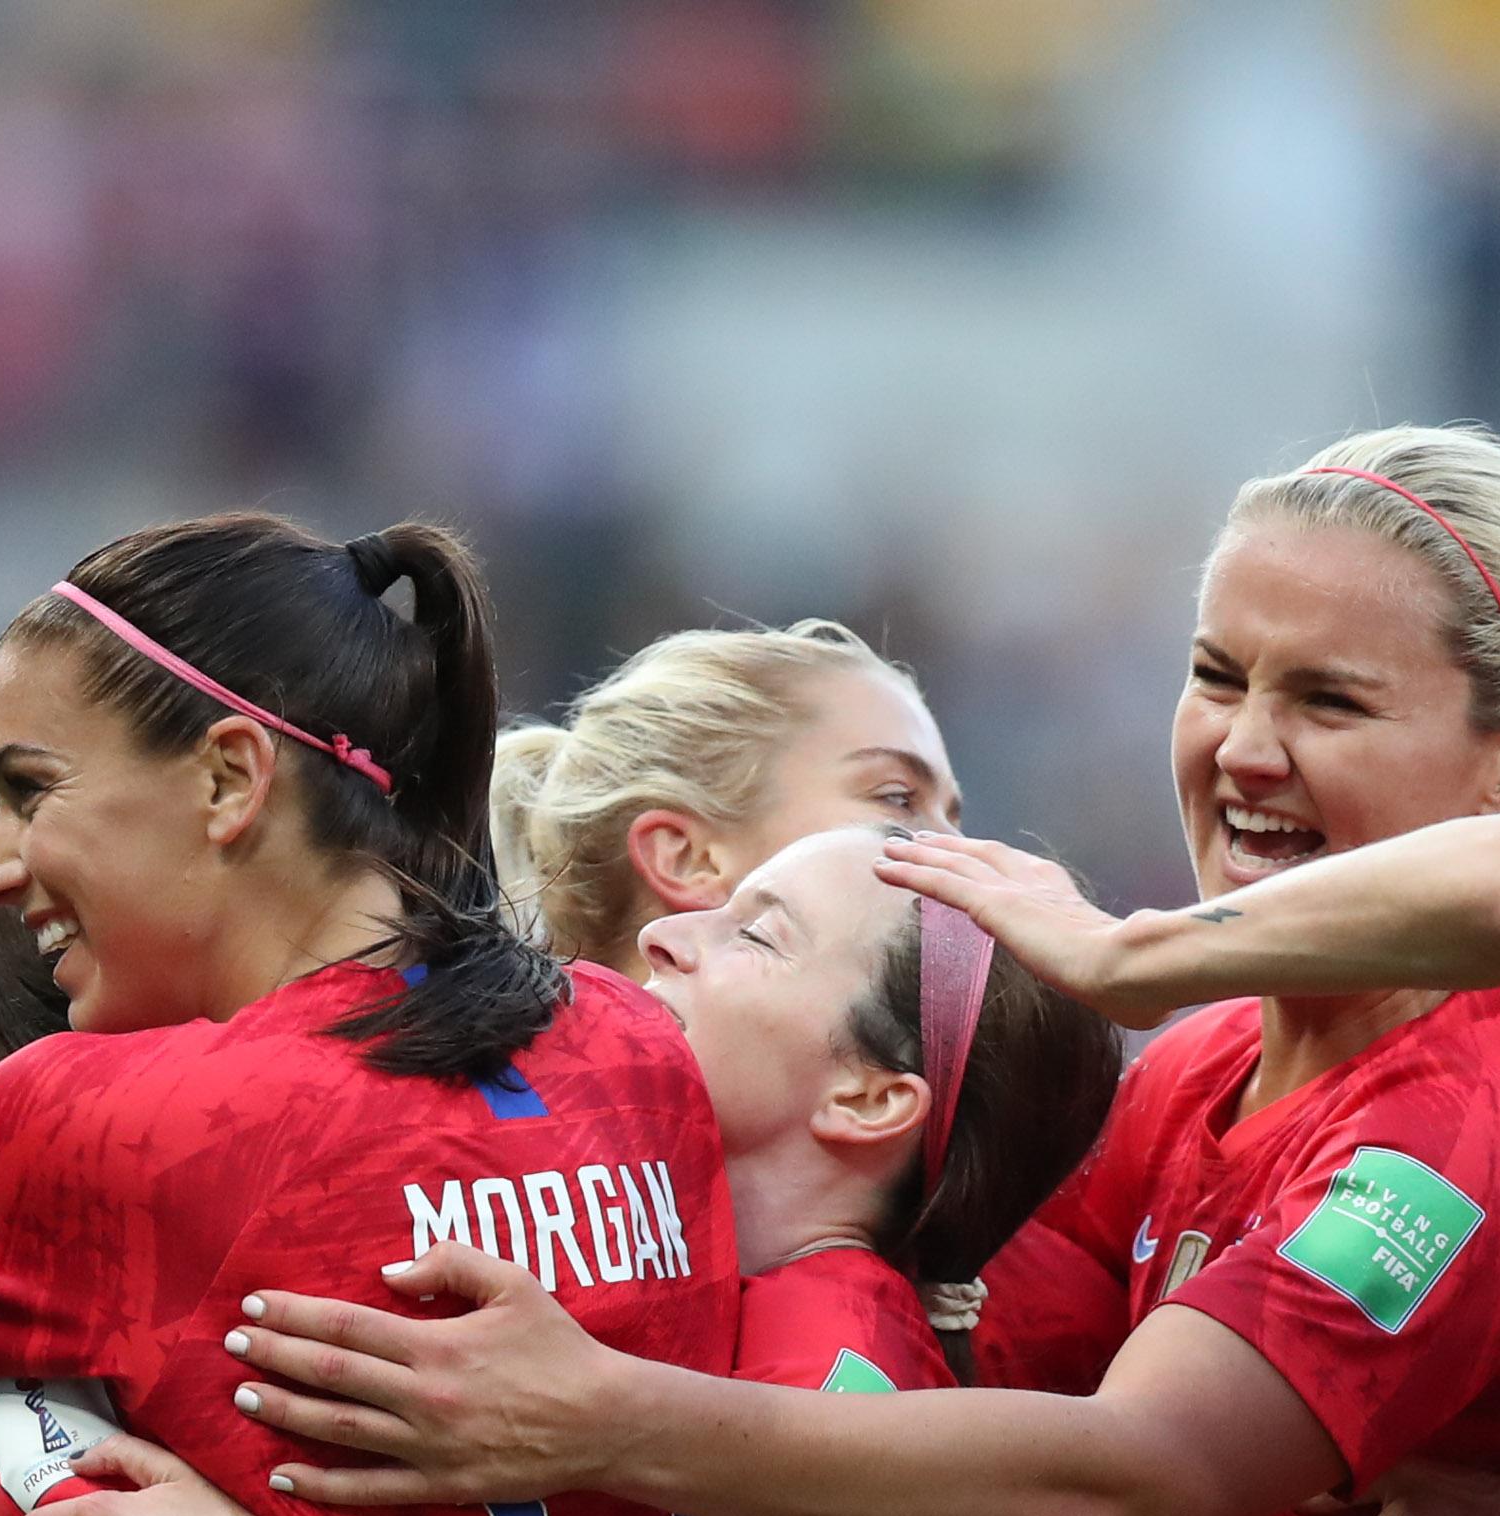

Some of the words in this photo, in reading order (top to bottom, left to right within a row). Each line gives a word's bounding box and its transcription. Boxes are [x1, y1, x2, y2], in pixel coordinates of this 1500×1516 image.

[403, 1160, 691, 1301] MORGAN
[1346, 1171, 1450, 1251] LIVING
[1371, 1245, 1415, 1293] FIFA
[45, 1437, 69, 1451] FIFA
[23, 1459, 72, 1494] FRANC
